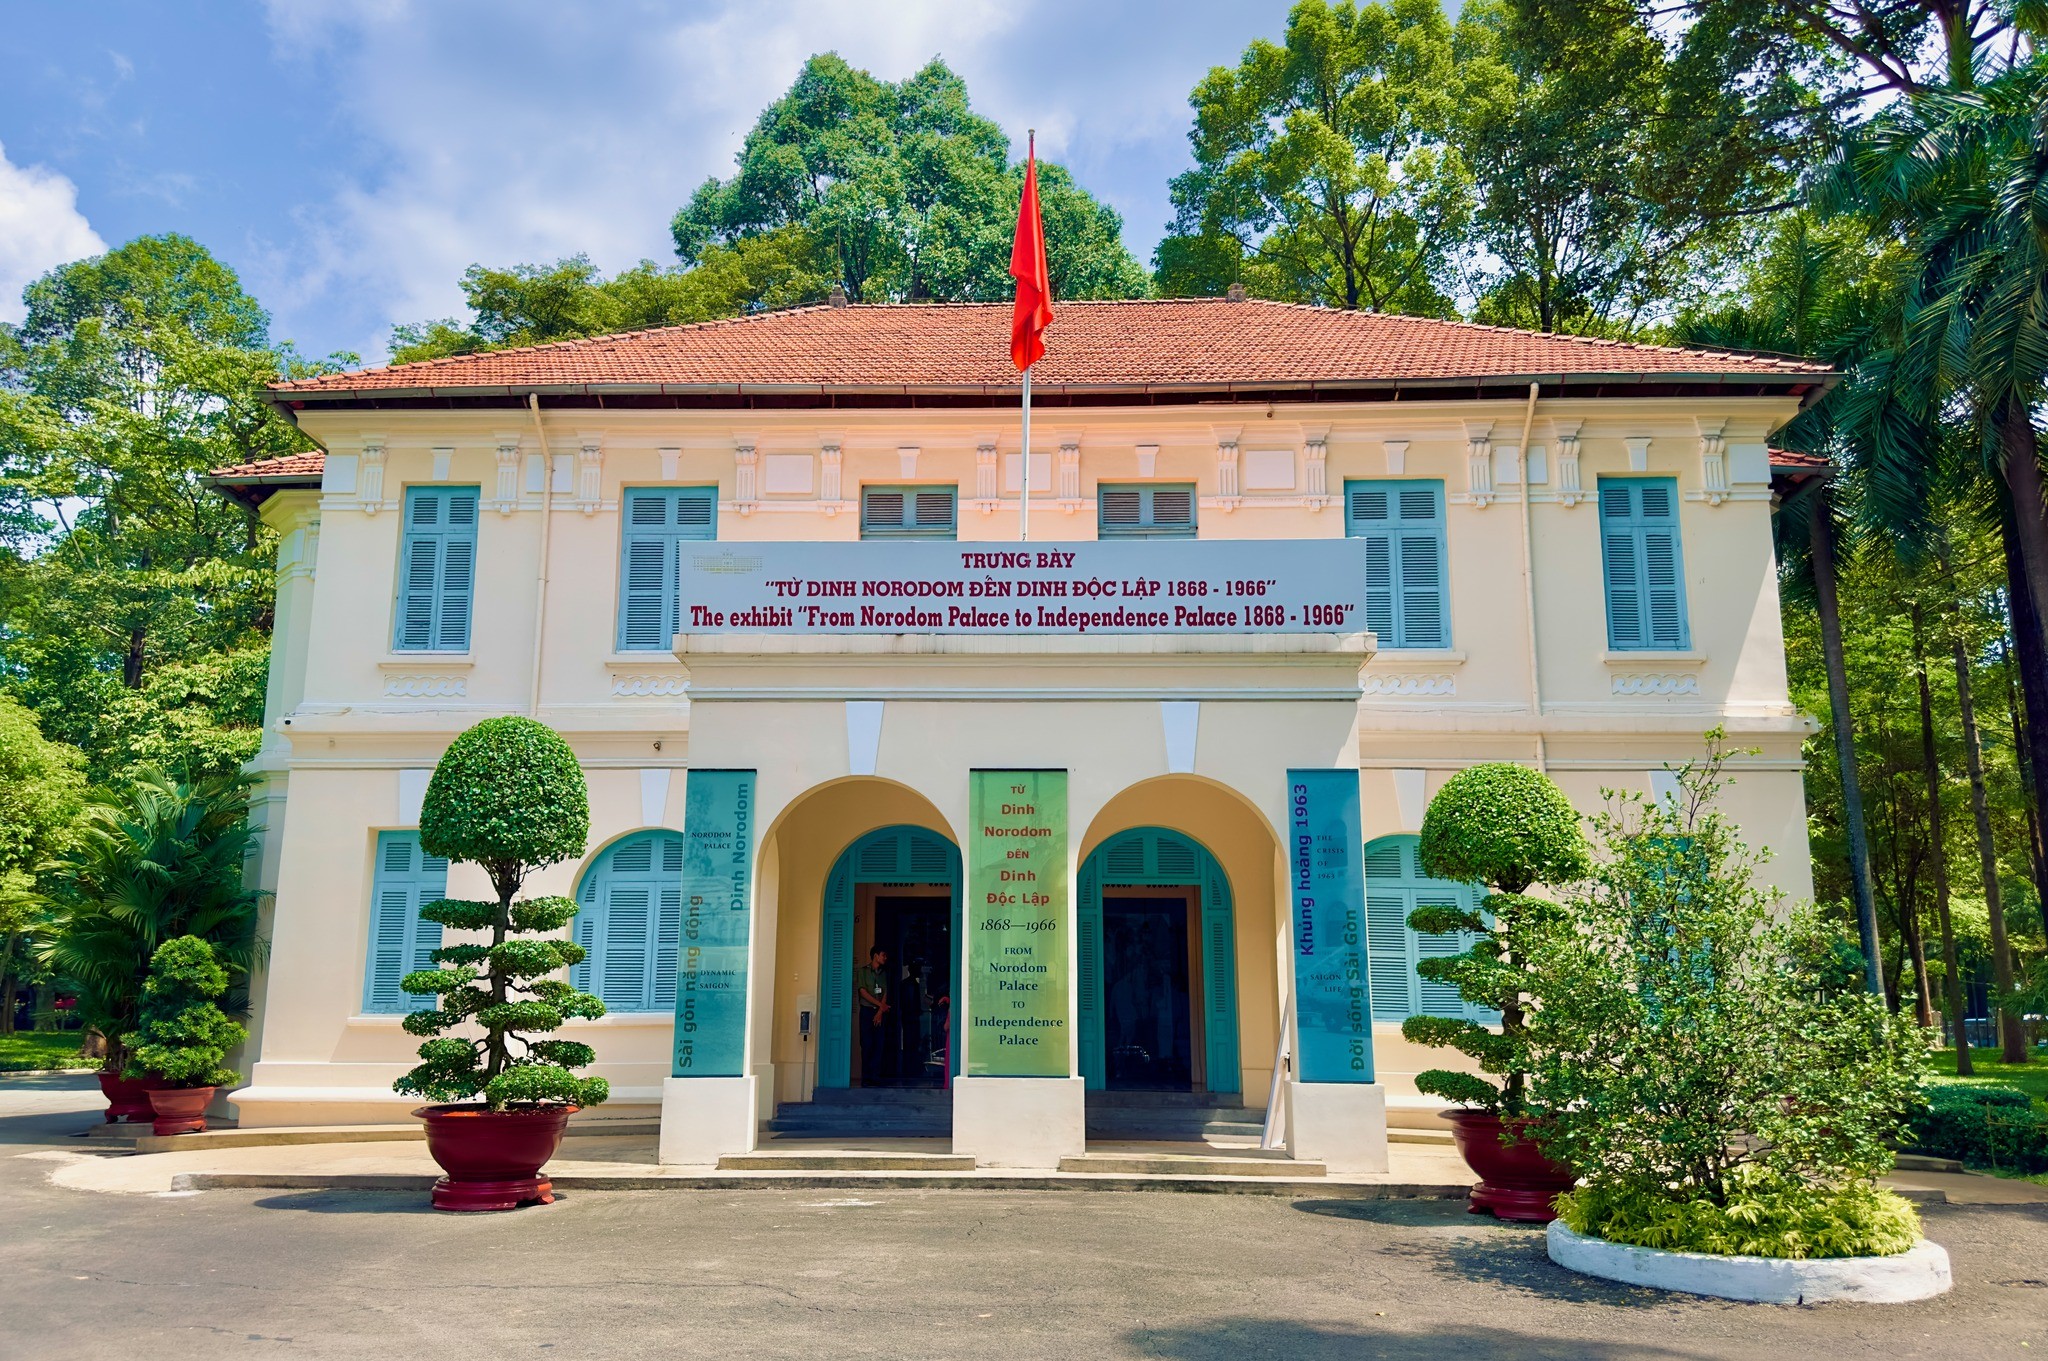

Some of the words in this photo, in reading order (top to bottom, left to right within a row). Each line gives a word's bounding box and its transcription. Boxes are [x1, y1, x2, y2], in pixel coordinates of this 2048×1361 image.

[961, 551, 1032, 569] TRƯNG
[1036, 548, 1076, 569] BÀY
[807, 581, 857, 597] DINH
[862, 581, 964, 597] NORODOM
[969, 575, 1012, 597] ĐẾN
[1016, 581, 1068, 597] DINH
[1072, 577, 1117, 600] ĐỘC
[1122, 577, 1161, 600] LẬP
[1167, 580, 1208, 597] 1868
[691, 606, 724, 627] The
[730, 606, 793, 627] exhibit
[861, 606, 943, 627] Norodom
[948, 606, 1010, 627] Palace
[1015, 608, 1033, 627] to
[1038, 606, 1169, 632] Independence
[1174, 606, 1237, 627] Palace
[1244, 605, 1285, 627] 1868
[1010, 783, 1026, 795] TỪ
[1001, 803, 1035, 815] Dinh
[1294, 783, 1309, 828] 1963
[732, 783, 749, 864] Norodom
[984, 826, 1052, 837] Norodom
[1006, 848, 1030, 859] ĐẾN
[1295, 835, 1312, 890] hoảng
[1000, 870, 1036, 881] Dinh
[730, 870, 745, 911] Dinh
[986, 892, 1016, 907] Độc
[1022, 892, 1050, 907] Lập
[685, 895, 703, 941] động
[1298, 897, 1315, 956] Khủng
[1343, 909, 1358, 946] Gòn
[1004, 947, 1032, 955] FROM
[683, 946, 700, 992] năng
[989, 962, 1047, 973] Norodom
[1344, 952, 1360, 980] Sài
[999, 980, 1039, 991] Palace
[680, 998, 697, 1033] gòn
[1012, 1001, 1025, 1009] TO
[1347, 987, 1364, 1033] sống
[974, 1016, 1063, 1030] Independence
[678, 1039, 693, 1068] Sài
[999, 1035, 1039, 1046] Palace
[1348, 1039, 1364, 1071] Đời
